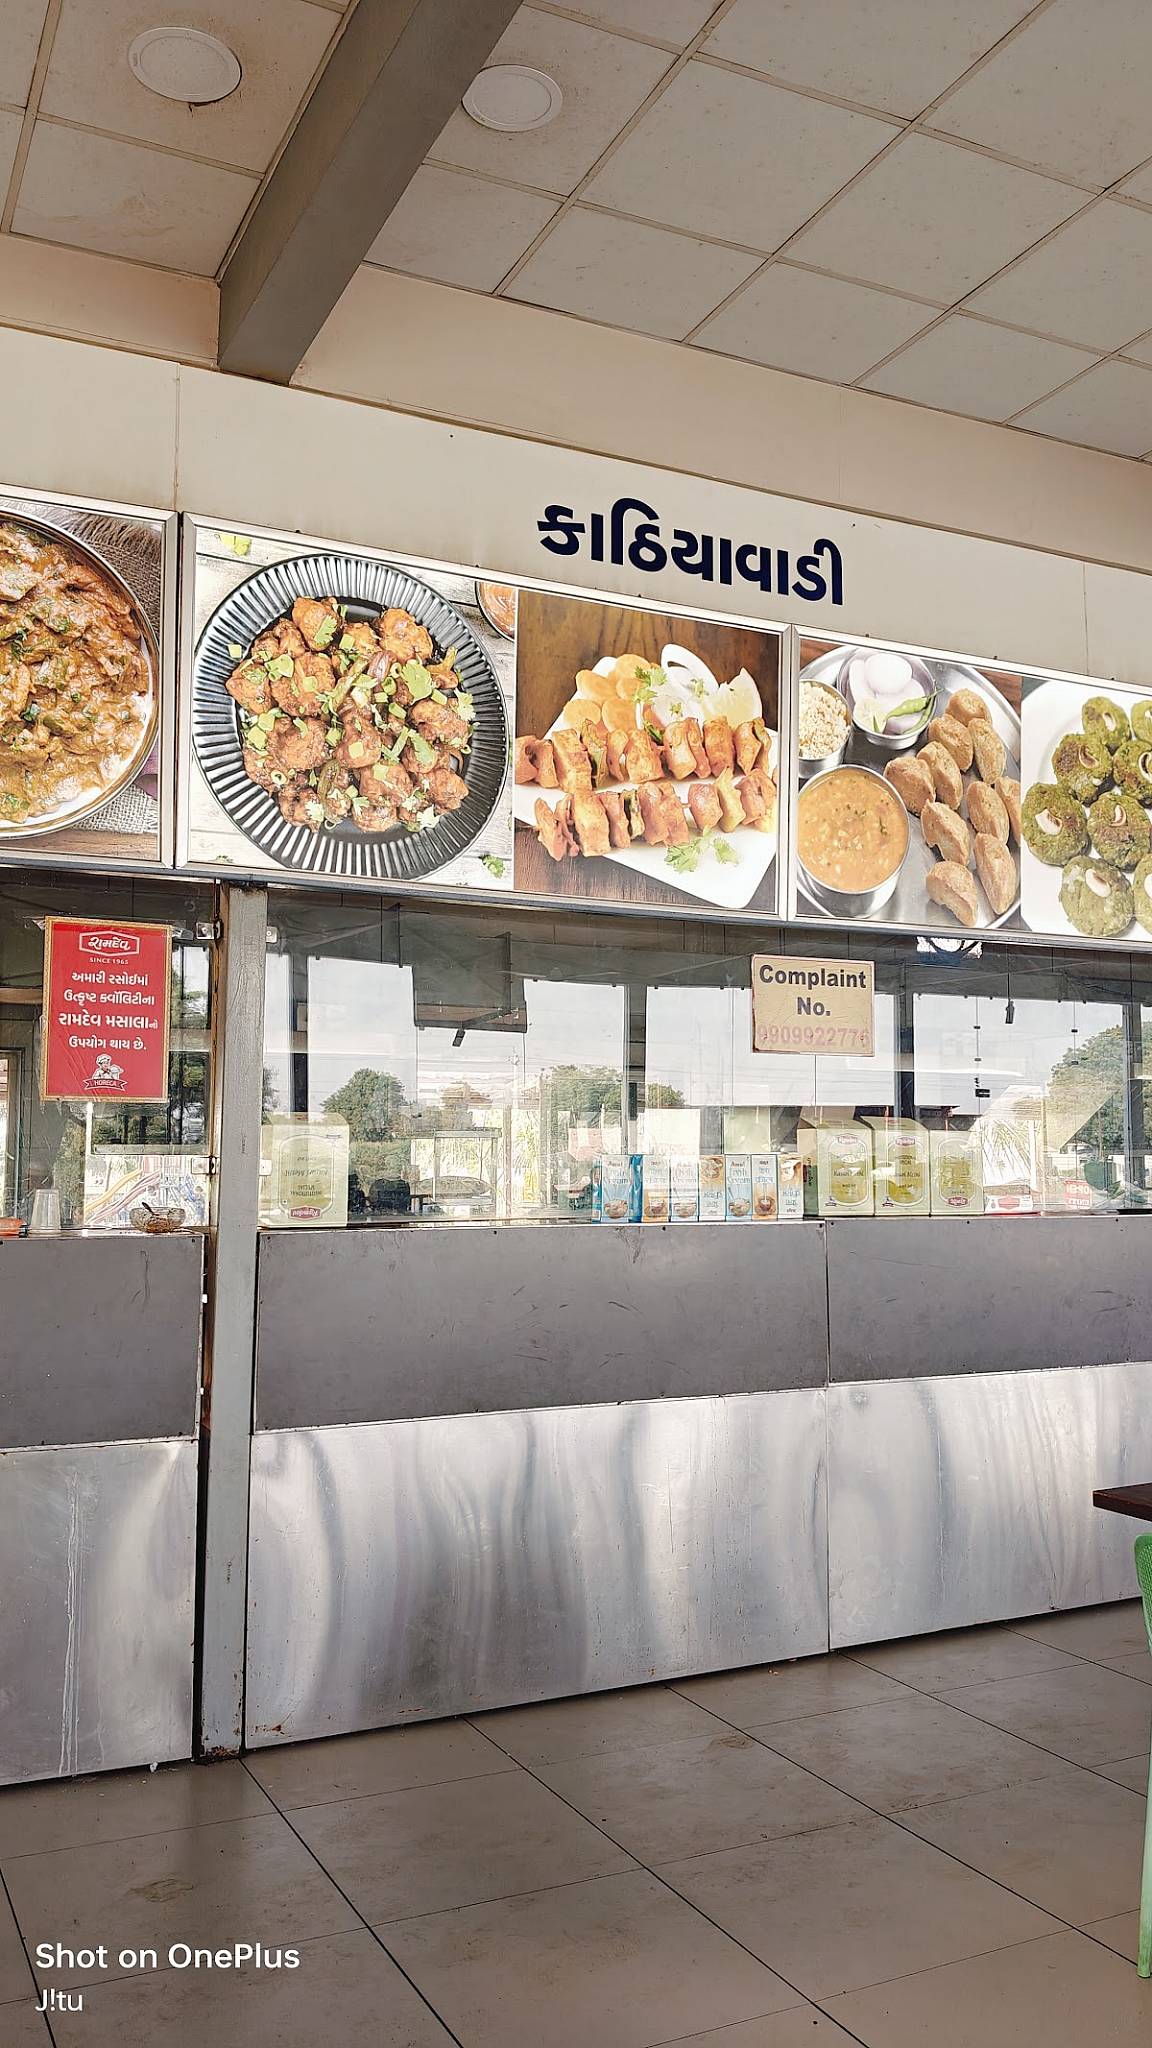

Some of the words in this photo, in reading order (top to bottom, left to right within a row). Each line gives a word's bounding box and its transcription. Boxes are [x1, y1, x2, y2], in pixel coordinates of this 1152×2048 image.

[537, 498, 843, 605] કાઠિયાવાડી
[88, 936, 131, 950] રામદેવ
[72, 970, 105, 984] અમારી
[760, 964, 866, 990] Complaint
[797, 996, 831, 1016] No.
[59, 1008, 101, 1027] રામદેવ
[69, 1034, 106, 1049] ઉપયોગ
[110, 1039, 130, 1049] થાય
